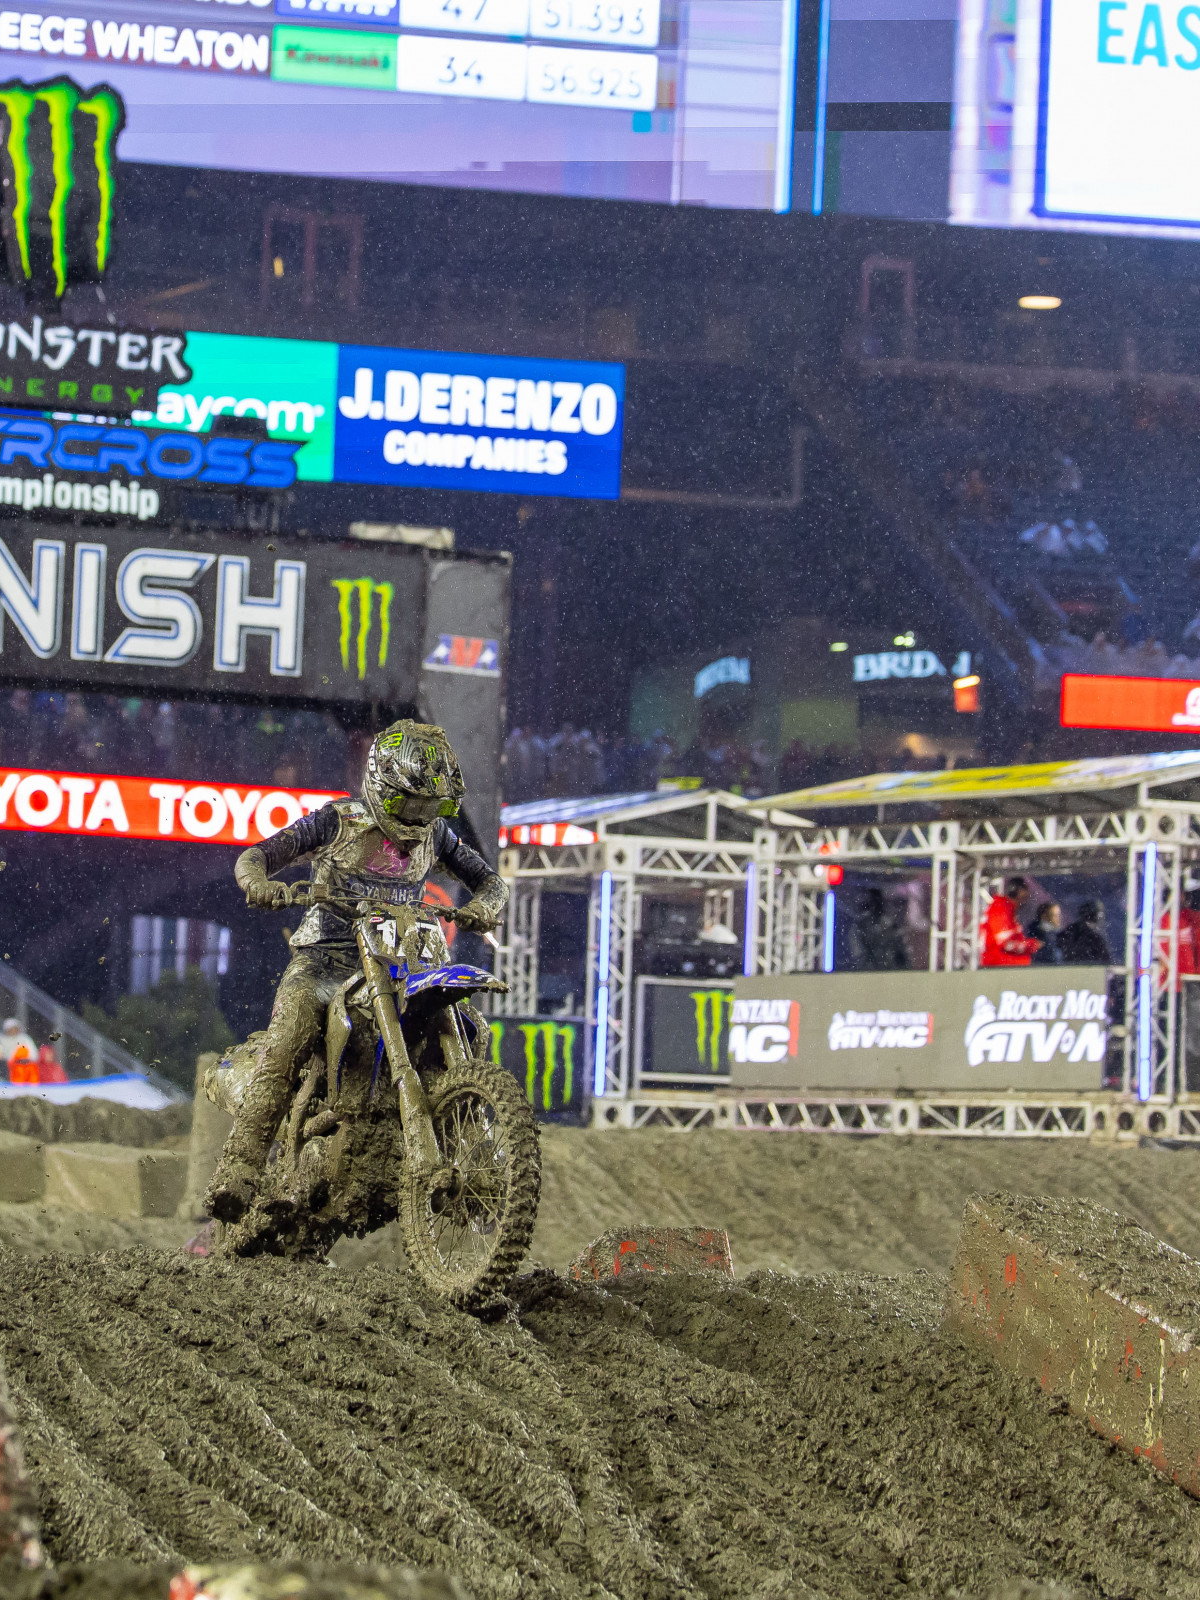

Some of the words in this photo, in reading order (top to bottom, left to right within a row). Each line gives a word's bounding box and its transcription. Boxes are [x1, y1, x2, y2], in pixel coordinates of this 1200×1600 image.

[92, 20, 270, 72] WHEATON
[438, 56, 484, 84] 34
[541, 64, 644, 99] 56.925
[1097, 1, 1200, 70] EAS
[156, 391, 316, 433] aycom
[338, 367, 618, 435] J.DERENZO
[383, 429, 568, 475] COMPANIES
[150, 784, 336, 841] TOYO
[365, 884, 415, 902] YAMAHA
